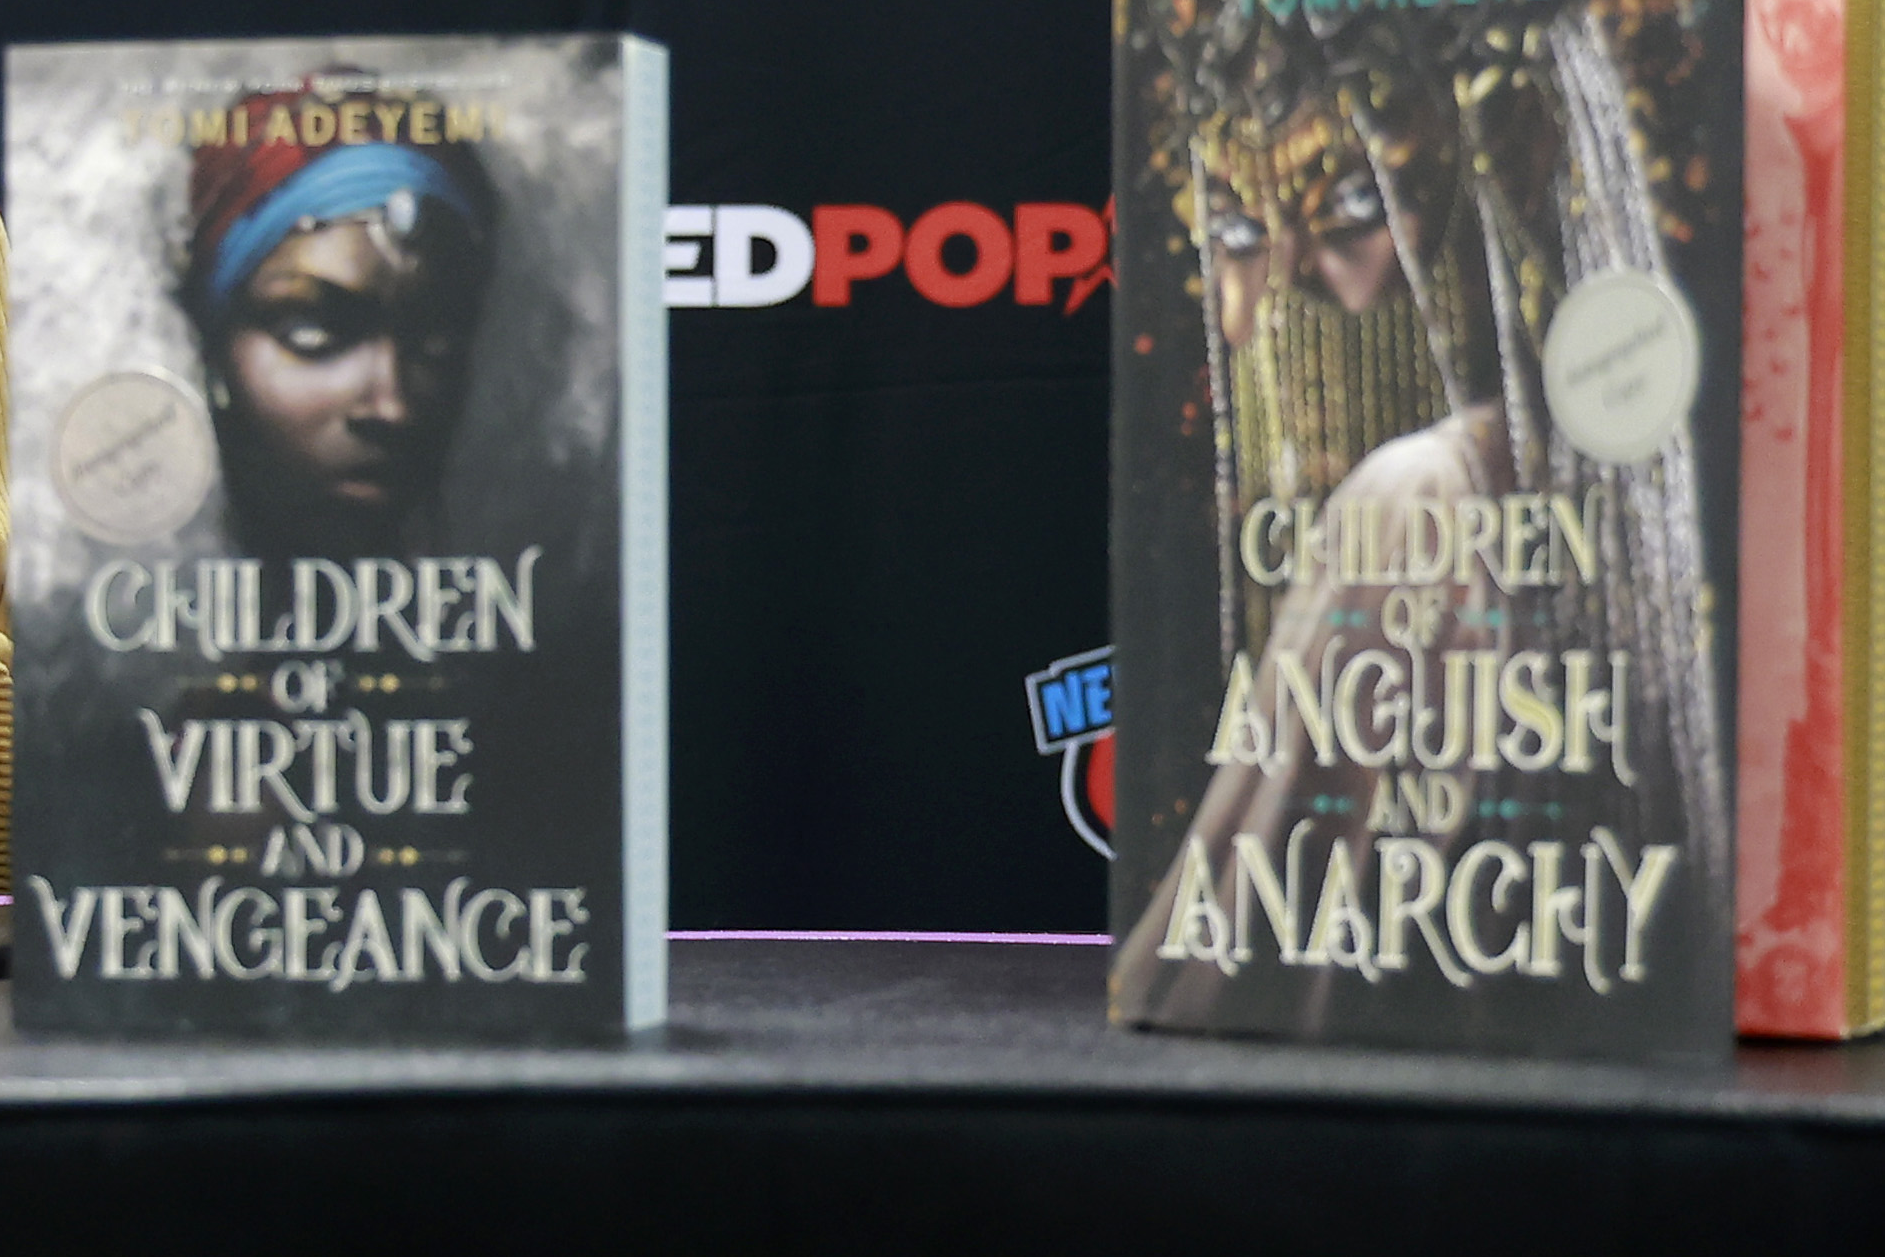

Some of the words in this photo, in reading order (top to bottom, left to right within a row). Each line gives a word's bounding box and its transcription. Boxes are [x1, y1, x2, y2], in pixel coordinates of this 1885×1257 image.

[121, 106, 249, 146] TOMI
[1239, 485, 1608, 594] CHILDREN
[84, 546, 543, 662] CHILDREN
[1380, 587, 1445, 650] OF
[270, 660, 345, 714] OF
[1205, 635, 1636, 786] ANGUISH
[137, 708, 474, 824] VIRTUE
[1366, 770, 1464, 835] AND
[260, 823, 367, 879] AND
[28, 875, 591, 993] VENGEANCE
[1156, 817, 1679, 995] ANARCHY
